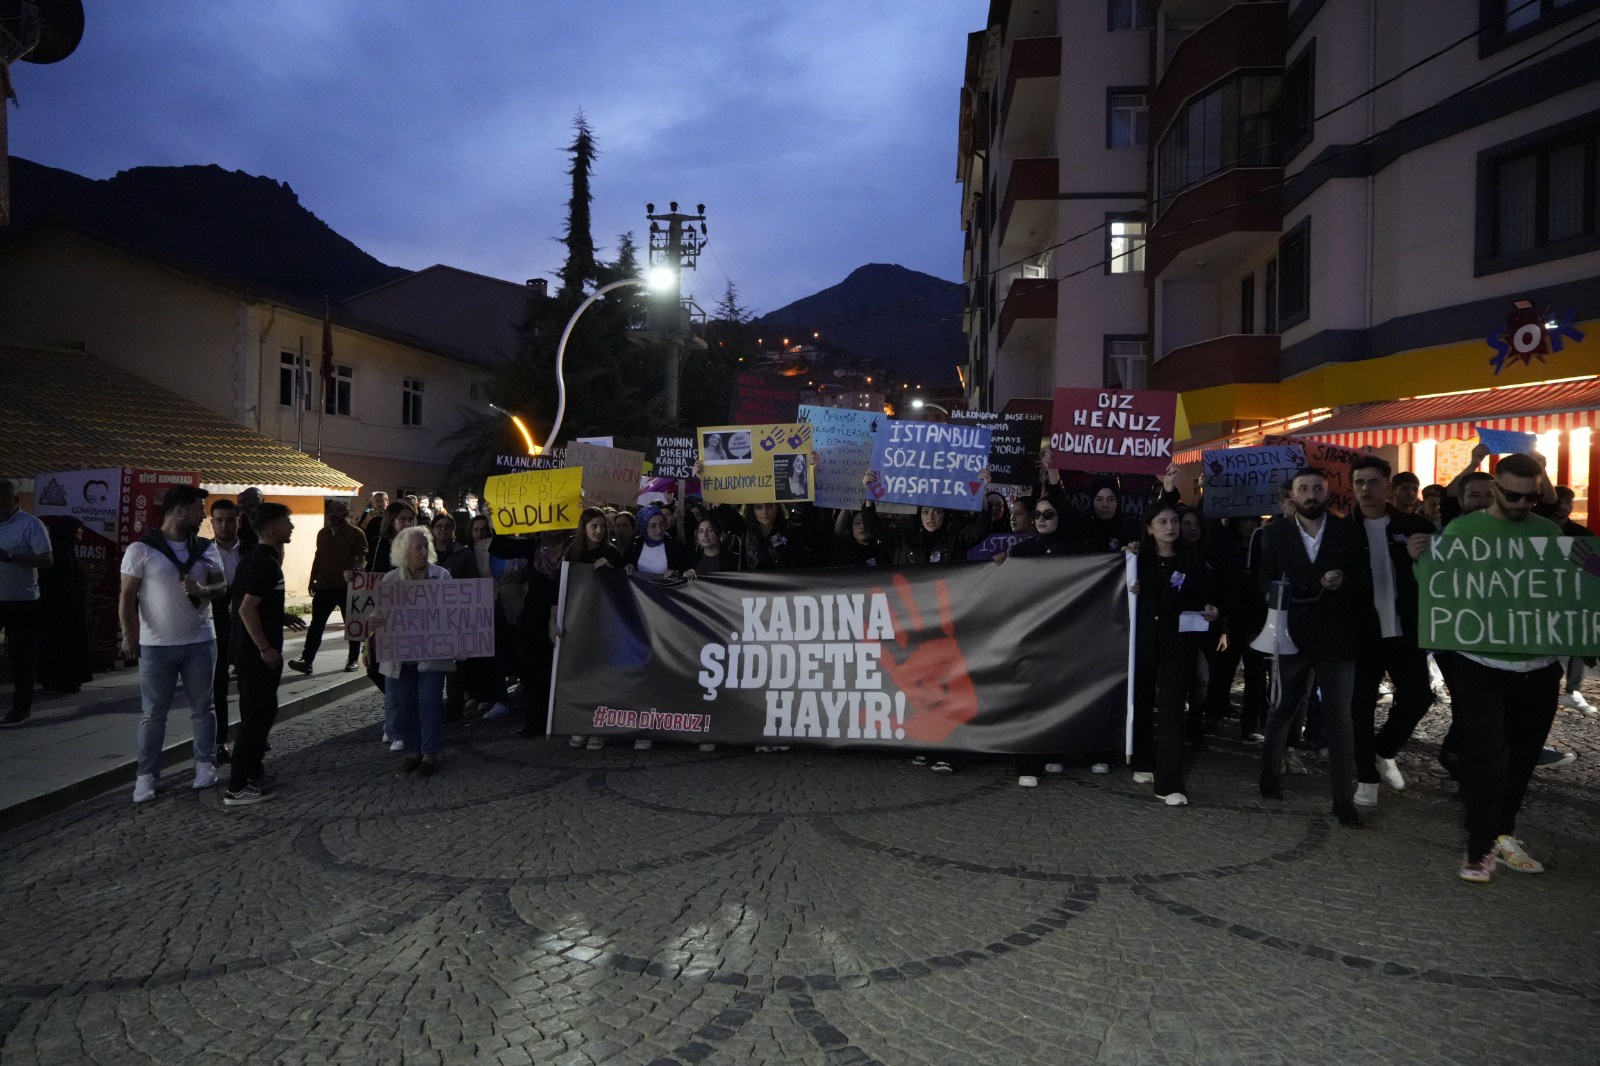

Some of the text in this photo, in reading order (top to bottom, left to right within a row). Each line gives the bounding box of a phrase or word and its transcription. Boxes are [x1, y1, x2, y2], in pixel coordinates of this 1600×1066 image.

[656, 436, 693, 448] KADININ
[656, 456, 687, 466] KADINA
[495, 483, 528, 505] HEP
[884, 475, 968, 498] YAŞATIR
[71, 505, 117, 517] GÜMÜŞHANE
[1429, 567, 1583, 601] CİNAYETİ
[742, 593, 895, 641] KADINA
[698, 631, 882, 701] ŞİDDETE
[593, 706, 637, 728] #DUR
[762, 691, 906, 740] HAYIR!
